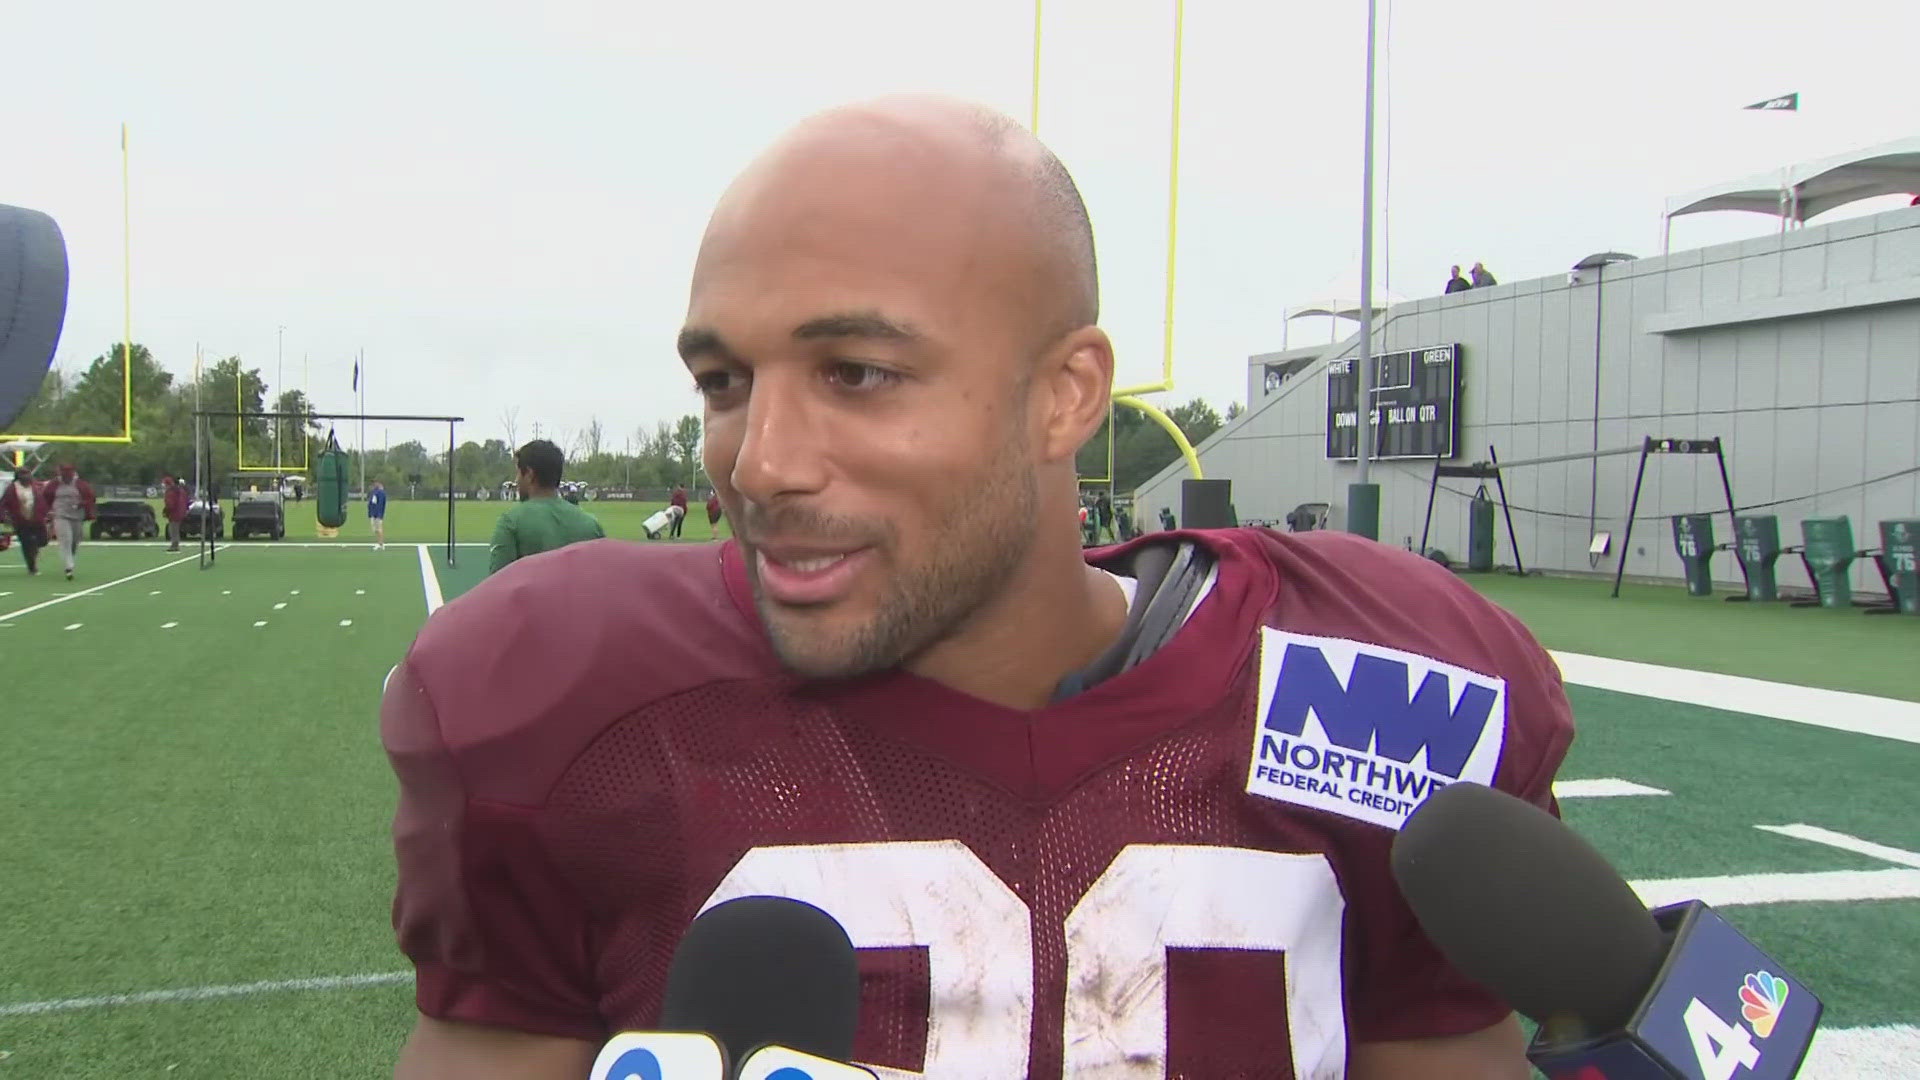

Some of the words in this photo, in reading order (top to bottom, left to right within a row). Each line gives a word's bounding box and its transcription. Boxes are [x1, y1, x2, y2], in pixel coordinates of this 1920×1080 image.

[1329, 361, 1351, 374] WHITE
[1424, 350, 1451, 364] GREEN
[1336, 412, 1357, 428] DOWN
[1388, 407, 1406, 424] BALL
[1406, 406, 1416, 422] ON
[1420, 405, 1436, 422] QTR
[1680, 541, 1696, 557] 76
[1264, 643, 1498, 780] NW
[1257, 765, 1343, 799] FEDERAL
[1348, 787, 1413, 817] CREDIT
[1683, 997, 1761, 1080] 4
